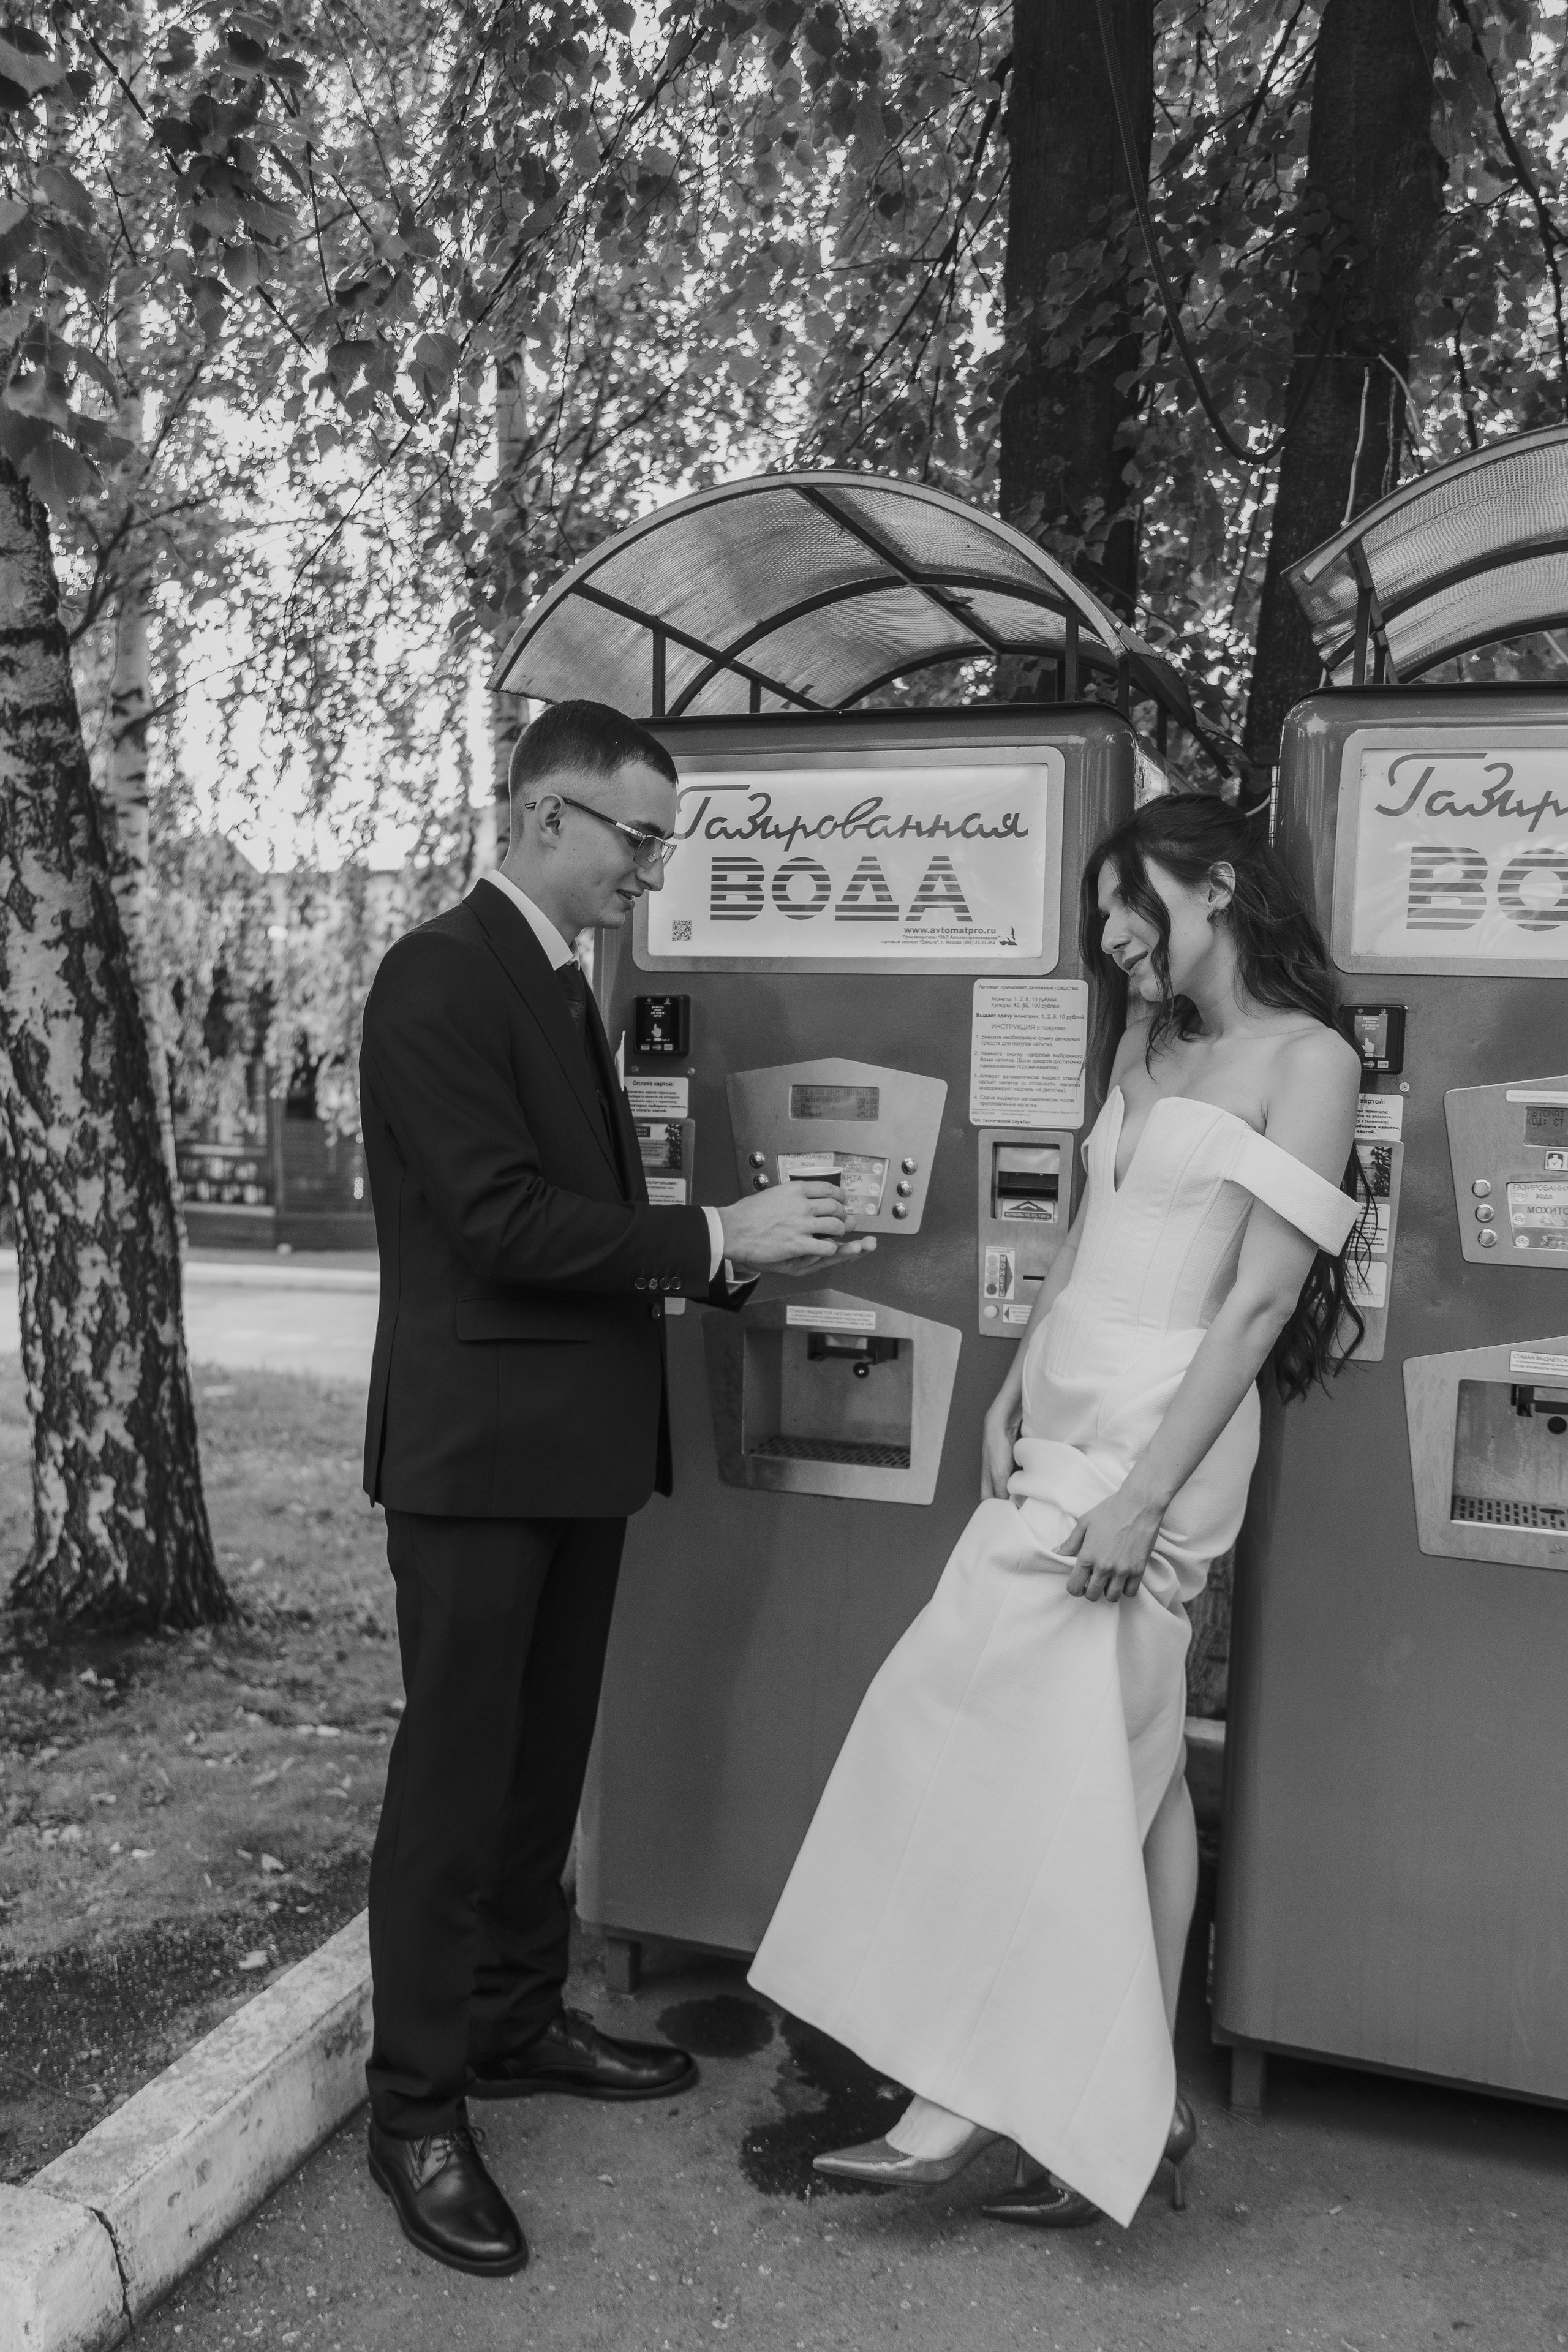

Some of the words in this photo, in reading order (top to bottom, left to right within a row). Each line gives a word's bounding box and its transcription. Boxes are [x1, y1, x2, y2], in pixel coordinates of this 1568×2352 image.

[672, 784, 1029, 852] Газированная
[710, 856, 973, 922] ВОДА
[904, 927, 996, 935] www.avtomatpro.ru
